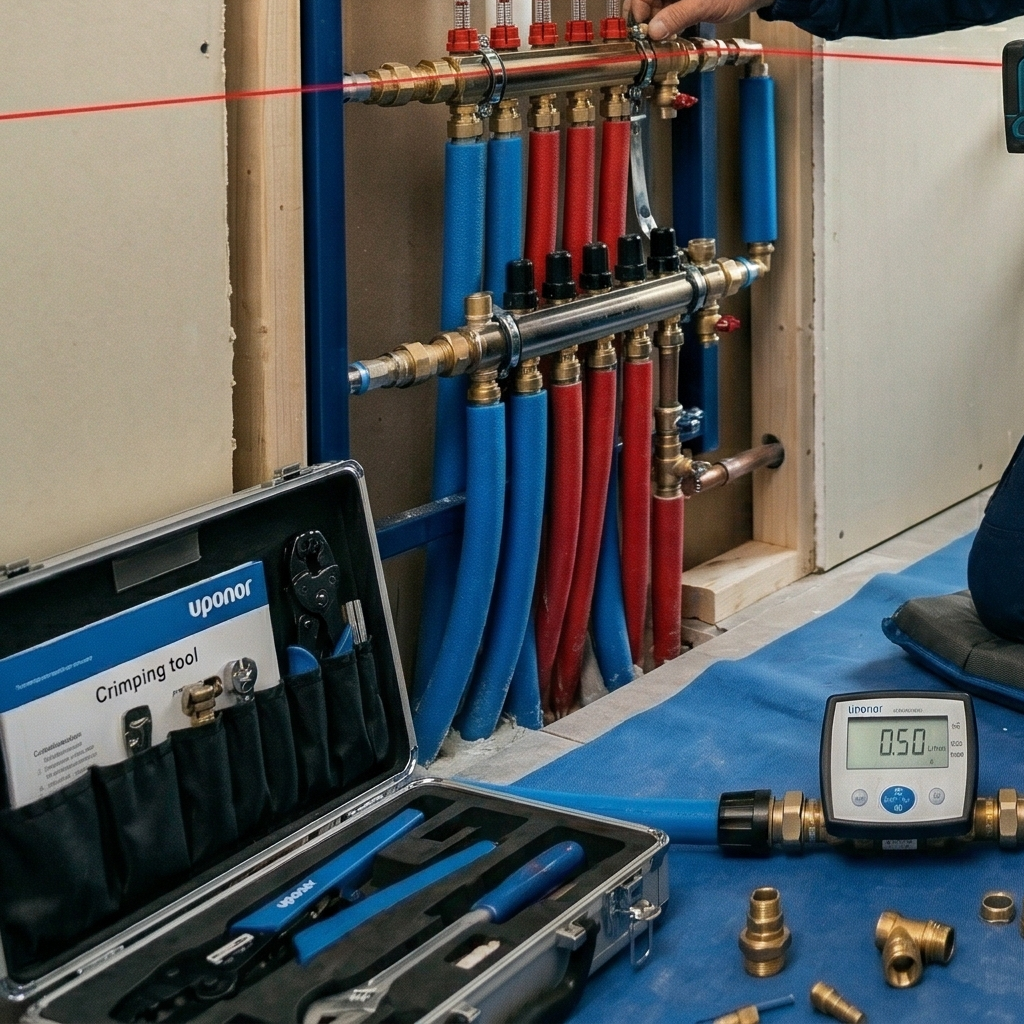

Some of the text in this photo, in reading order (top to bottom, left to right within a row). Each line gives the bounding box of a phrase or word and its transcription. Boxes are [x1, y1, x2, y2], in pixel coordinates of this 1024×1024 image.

[188, 578, 253, 618] uponor
[95, 664, 167, 703] Crimping
[169, 646, 198, 672] tool
[879, 728, 926, 756] 0.50
